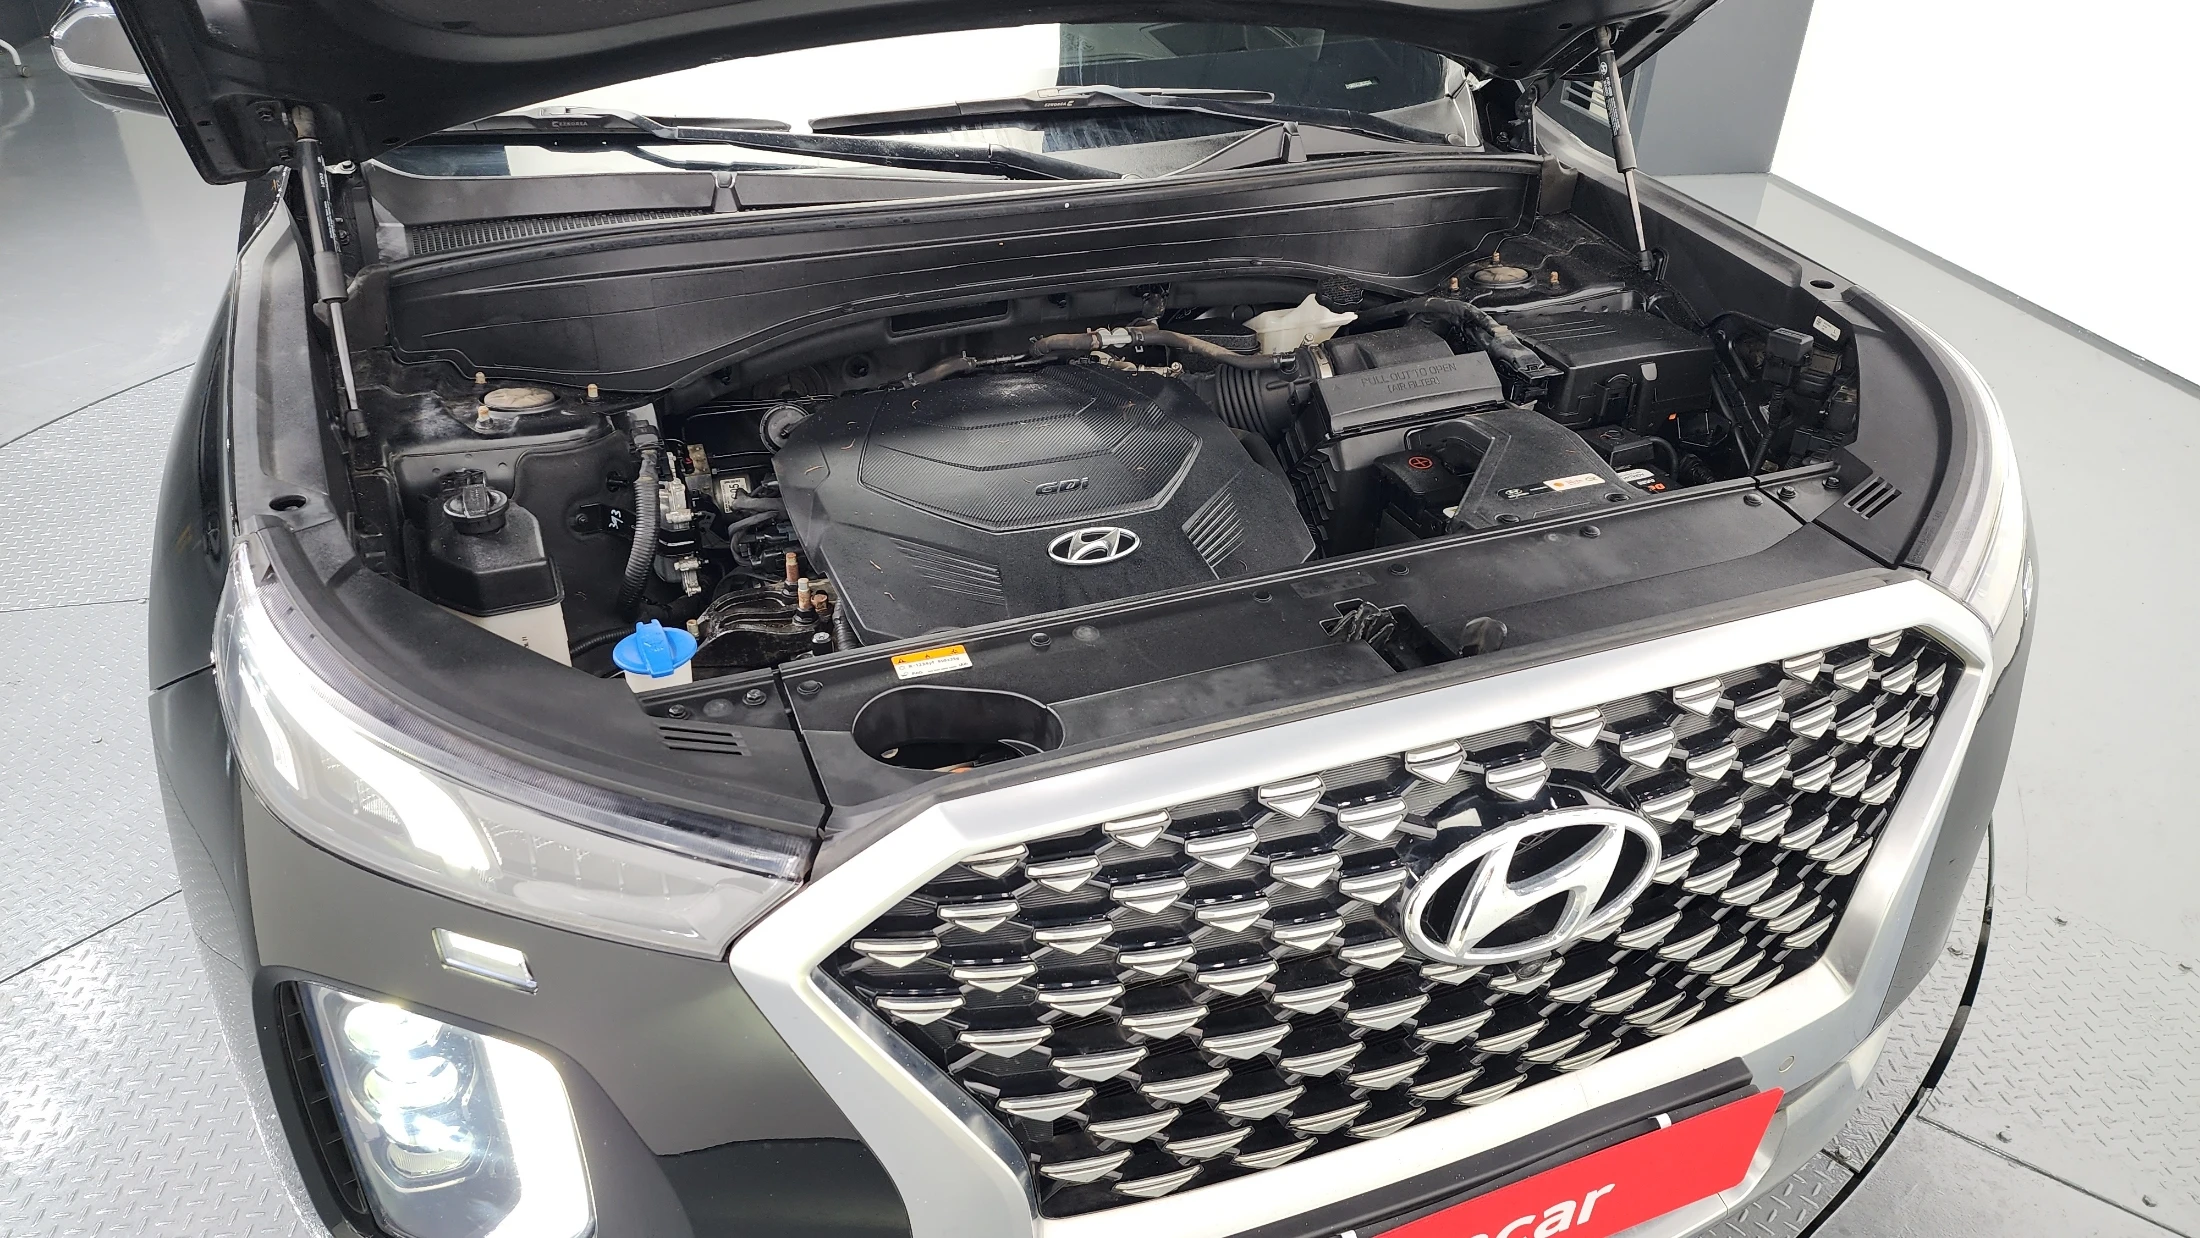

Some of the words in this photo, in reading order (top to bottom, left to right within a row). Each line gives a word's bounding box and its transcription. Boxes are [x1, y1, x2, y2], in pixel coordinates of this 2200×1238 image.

[1361, 375, 1389, 387] PULL
[1390, 370, 1412, 380] OUT
[1413, 367, 1428, 377] TO
[1428, 363, 1457, 374] OPEN
[1387, 382, 1407, 393] (AIR
[1408, 376, 1441, 389] FILTER)
[609, 509, 624, 530] 393
[1470, 1183, 1616, 1238] car
